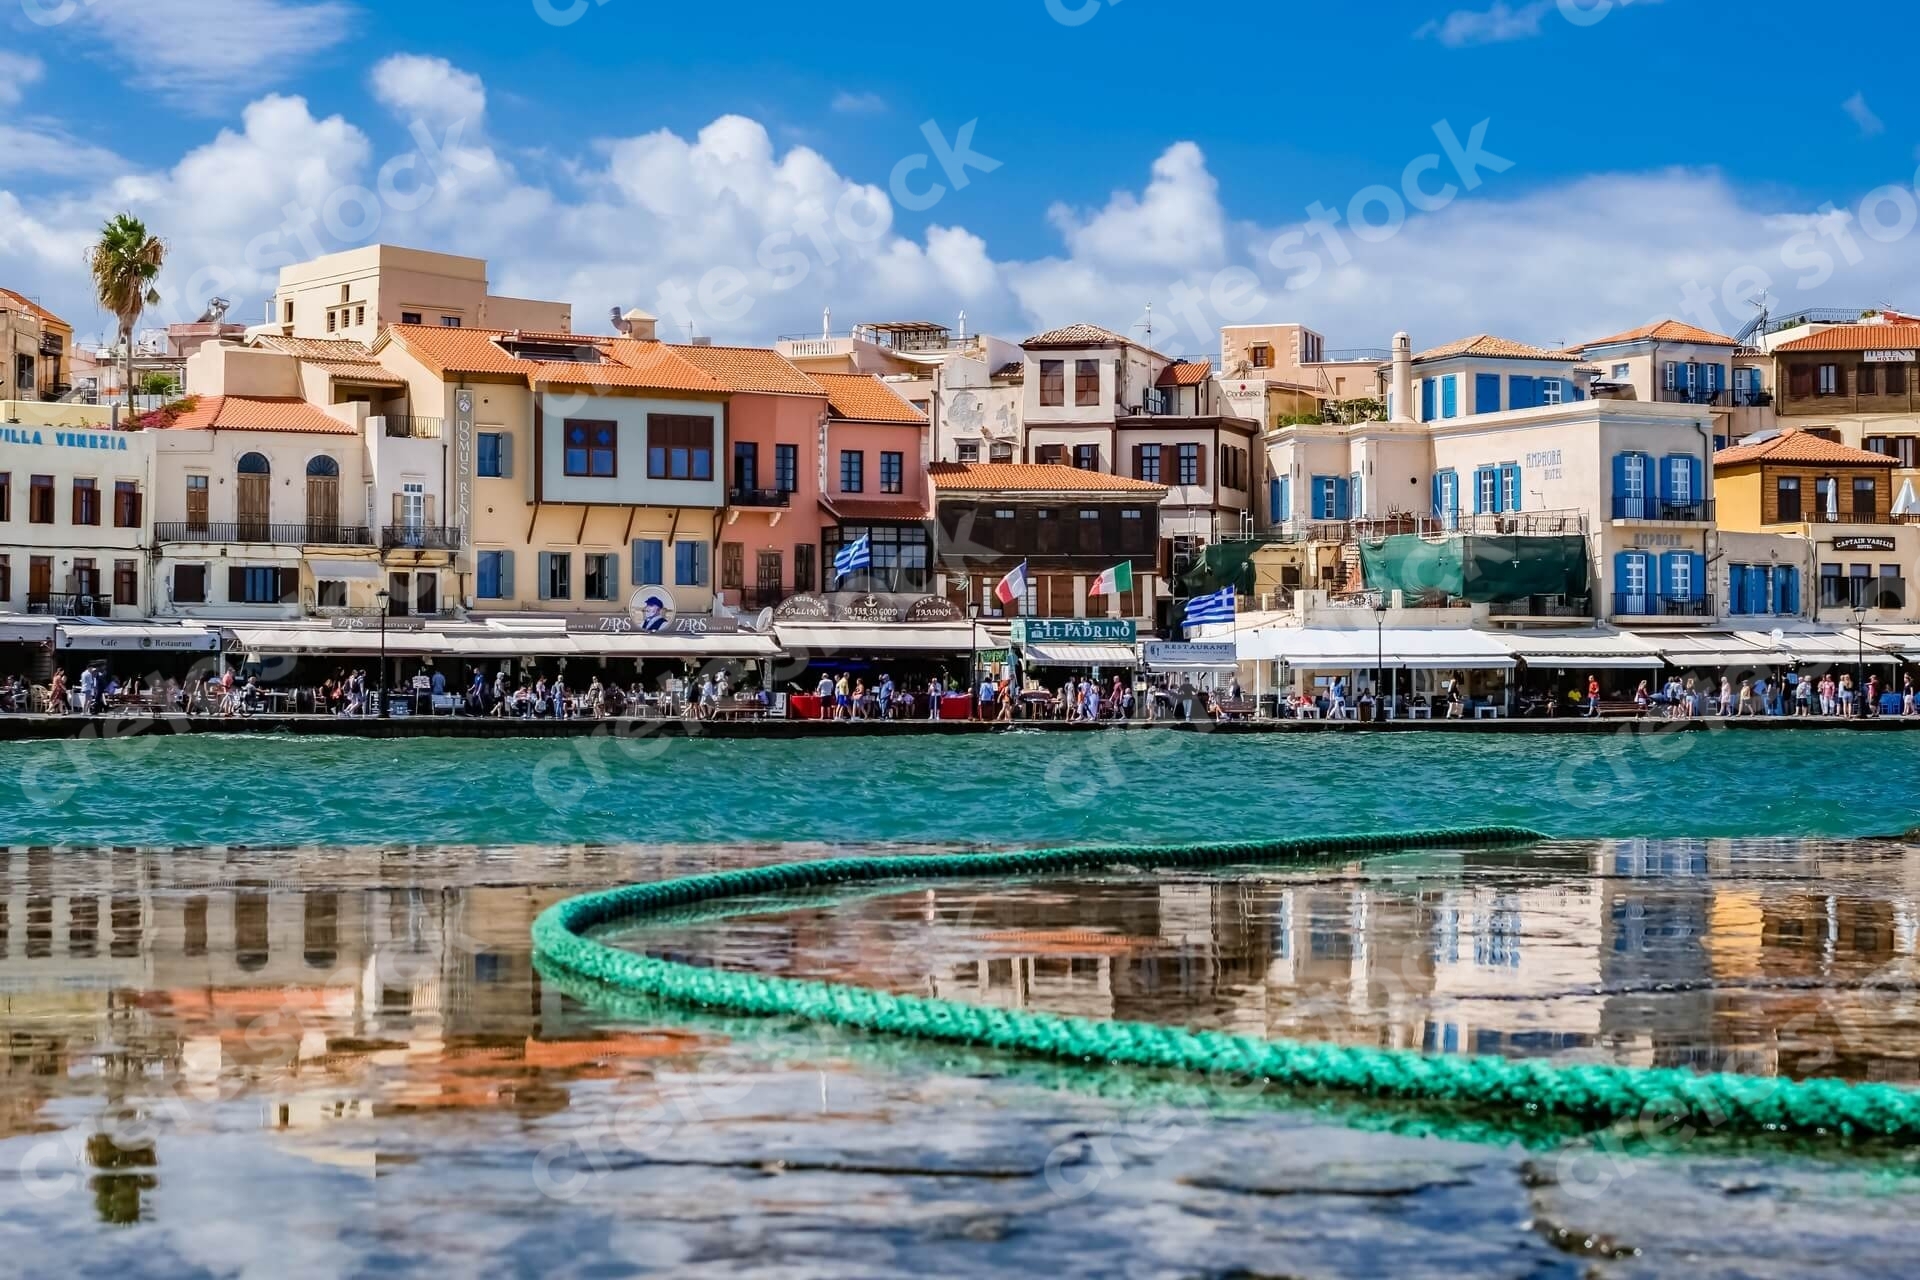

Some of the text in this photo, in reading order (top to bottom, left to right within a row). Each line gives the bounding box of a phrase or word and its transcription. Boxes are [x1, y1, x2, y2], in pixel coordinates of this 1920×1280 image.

[56, 432, 127, 450] VENEZIA
[1526, 449, 1562, 468] AMPHORA
[1544, 468, 1562, 480] HOTEL
[459, 420, 470, 546] DOMUS RENIER
[1634, 533, 1682, 545] AMPHORA
[1836, 538, 1865, 548] CAPTAIN
[854, 607, 869, 616] FAR
[879, 608, 898, 616] GOOD
[1045, 623, 1130, 638] IL PADRINO
[155, 639, 192, 648] Restaurant
